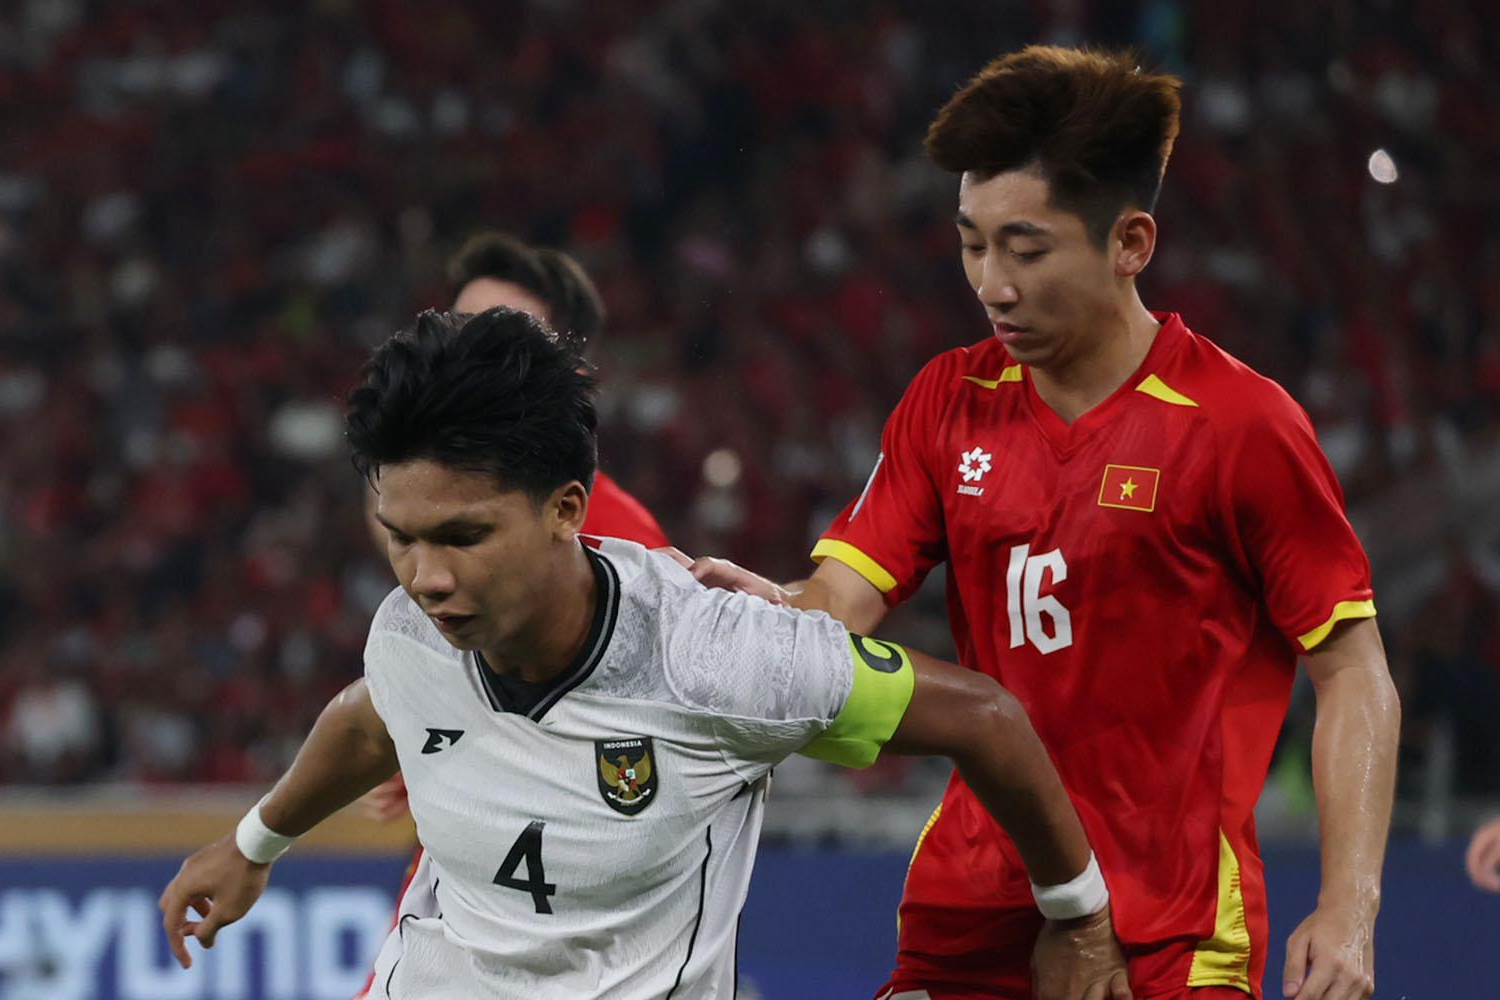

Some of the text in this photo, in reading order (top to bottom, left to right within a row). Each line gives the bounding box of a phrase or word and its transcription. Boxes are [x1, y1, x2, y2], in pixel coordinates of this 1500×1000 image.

[1006, 543, 1074, 655] 16
[603, 740, 642, 749] INDONESIA
[492, 820, 557, 915] 4
